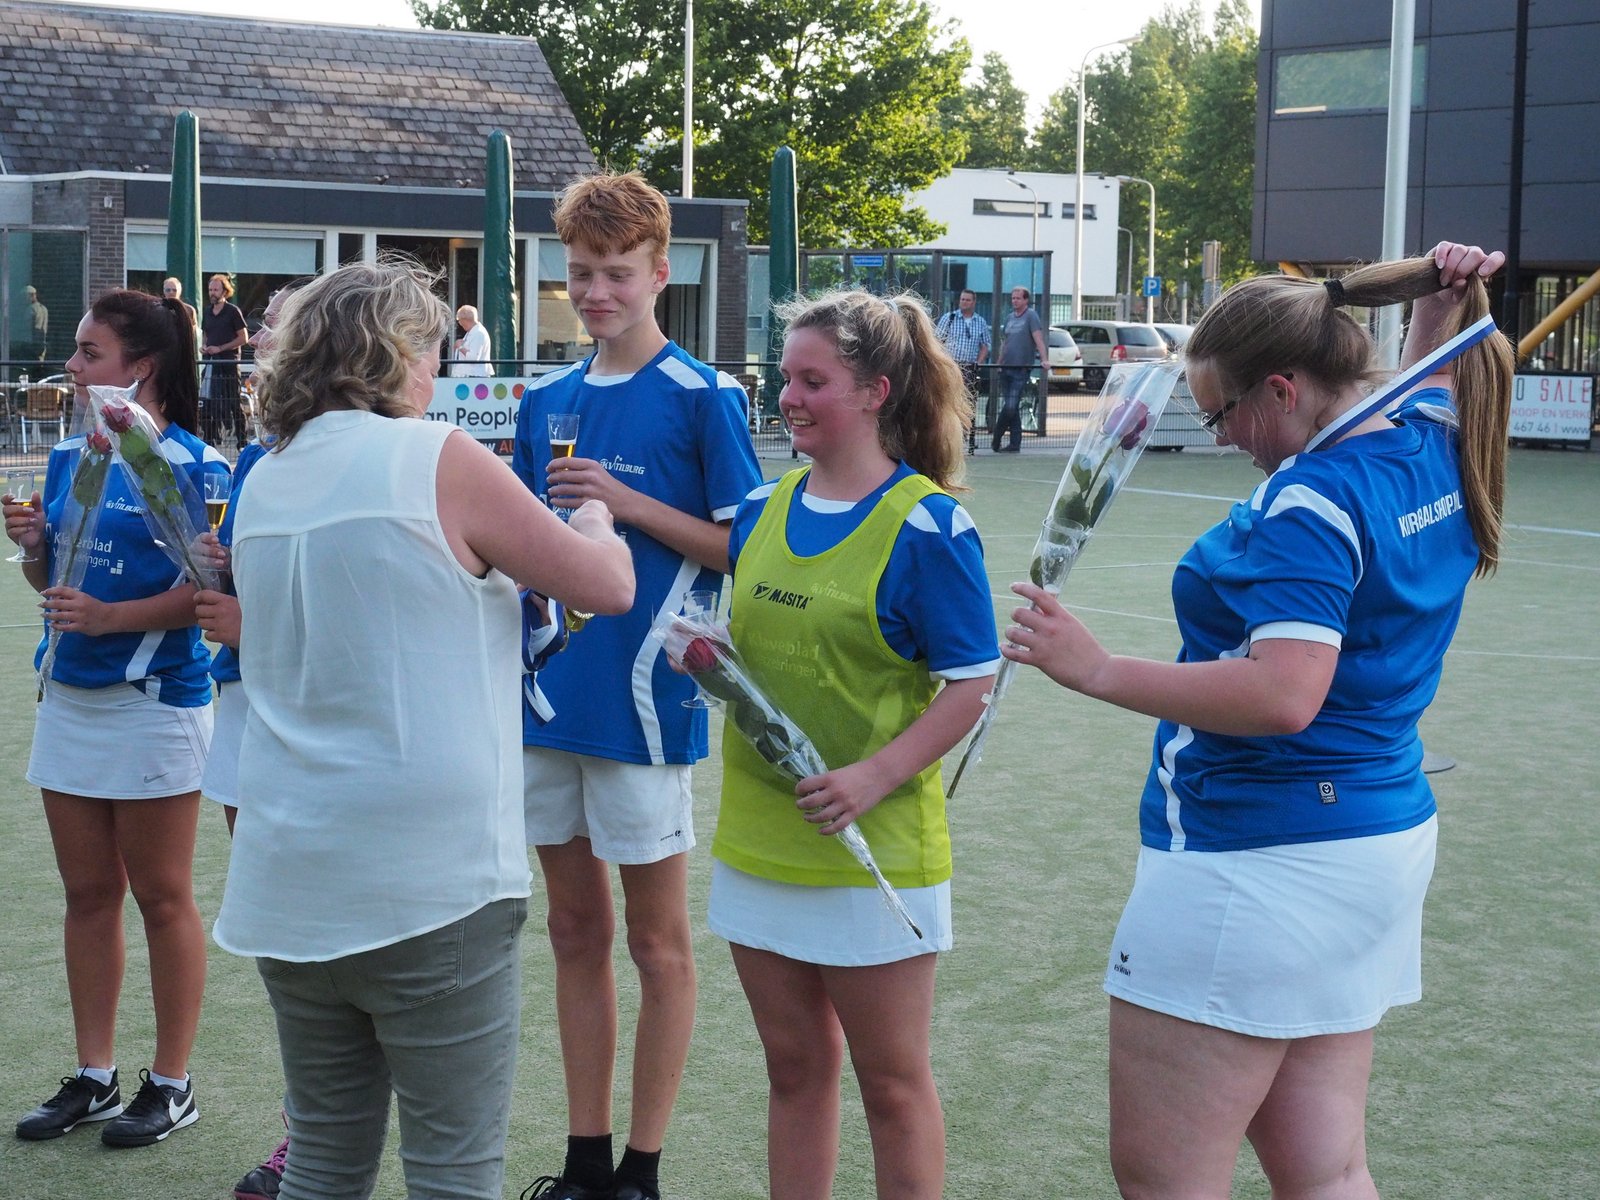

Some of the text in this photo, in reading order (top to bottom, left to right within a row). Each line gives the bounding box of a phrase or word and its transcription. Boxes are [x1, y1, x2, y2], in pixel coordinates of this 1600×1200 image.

[1147, 279, 1158, 295] P
[1516, 377, 1591, 403] O SALE
[423, 410, 448, 422] an
[1542, 408, 1556, 418] EN
[768, 588, 810, 610] MASITA
